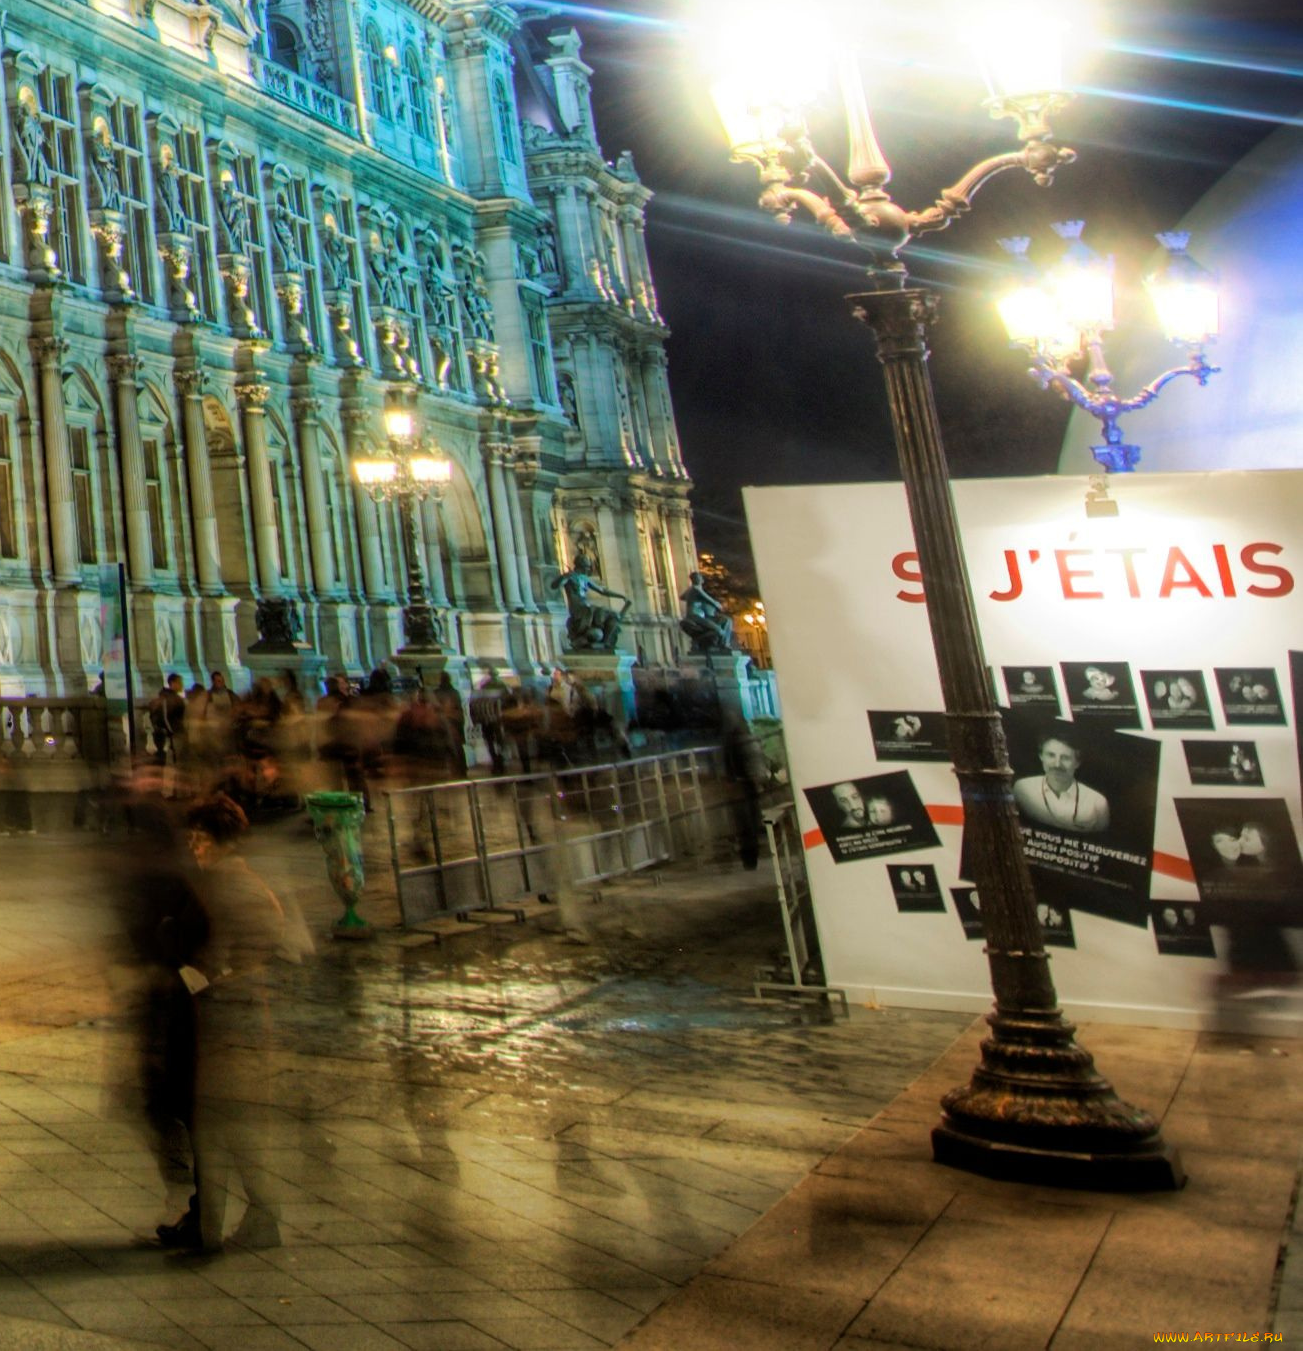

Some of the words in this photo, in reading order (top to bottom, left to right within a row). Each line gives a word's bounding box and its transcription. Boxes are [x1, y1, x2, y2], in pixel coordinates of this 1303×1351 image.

[988, 531, 1295, 601] J'ÉTAIS
[1035, 831, 1062, 844] VOUS
[1064, 837, 1079, 847] ME
[1082, 841, 1148, 867] TROUVERIEZ
